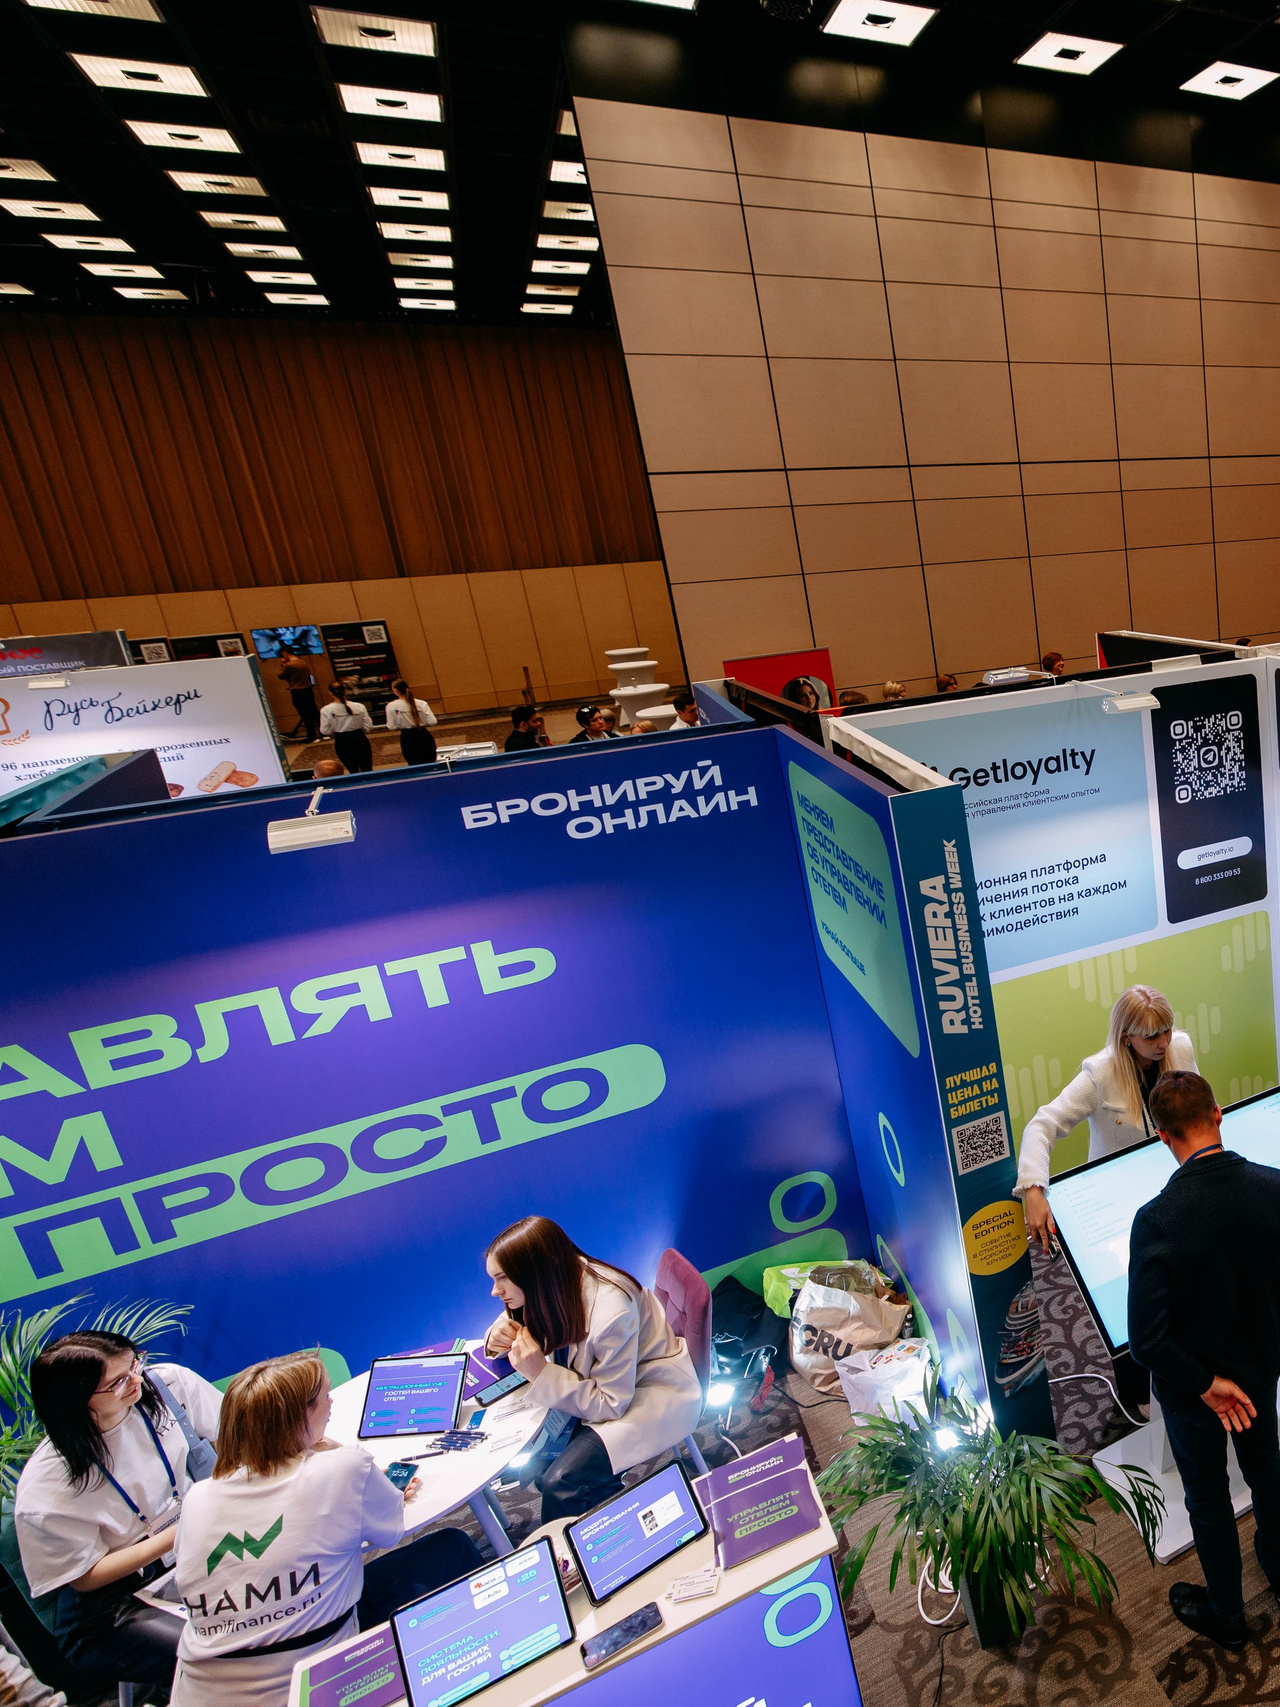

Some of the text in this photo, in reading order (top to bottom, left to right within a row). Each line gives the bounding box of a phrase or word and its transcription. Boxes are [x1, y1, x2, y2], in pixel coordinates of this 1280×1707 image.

[18, 660, 86, 673] ПОСТАВЩИК
[43, 688, 203, 731] Русь Бейкери
[1, 762, 18, 772] 96
[948, 748, 1097, 791] Getloyalty
[460, 759, 723, 830] БРОНИРУЙ
[971, 788, 1101, 819] управления клиентским опытом
[1004, 788, 1050, 803] платформа
[796, 790, 836, 834] МЕНЯЕМ
[801, 816, 886, 902] ПРЕДСТАВЛЕНИЕ
[1030, 853, 1107, 879] платформа
[1197, 846, 1234, 862] getloyalty.io
[806, 841, 888, 930] ОБ УПРАВЛЕНИИ
[811, 866, 848, 914] ОТЕЛЕМ
[1031, 875, 1079, 895] потока
[1200, 874, 1212, 884] 800
[1213, 872, 1224, 880] 333
[1224, 870, 1232, 878] 09
[1234, 868, 1241, 876] 53
[989, 897, 1056, 920] клиентов
[1058, 891, 1075, 904] на
[1077, 880, 1128, 900] каждом
[942, 838, 984, 1030] HOTEL BUSINESS WEEK
[919, 874, 969, 1034] RUVIERA
[945, 1062, 998, 1090] ЛУЧШАЯ
[947, 1077, 1000, 1105] ЦЕНА НА
[950, 1093, 999, 1119] БИЛЕТЫ
[14, 1067, 610, 1280] ПРОСТО
[971, 1209, 1016, 1232] SPECIAL
[974, 1218, 1016, 1240] EDITION
[978, 1235, 1022, 1257] СТИЛИСТИКЕ
[980, 1232, 1013, 1249] СОБЫТИЕ
[980, 1243, 1017, 1262] МОРСКОГО
[986, 1252, 1013, 1267] КРУИЗА
[728, 1456, 777, 1480] БРОНИРУЙ
[582, 1502, 640, 1540] БРОНИРОВАНИЯ
[726, 1490, 800, 1524] УПРАВЛЯТЬ
[739, 1500, 790, 1525] ОТЕЛЕМ
[580, 1516, 610, 1536] МОДУЛЬ
[739, 1508, 794, 1536] ПРОСТО
[183, 1562, 321, 1618] НАМИ
[194, 1592, 322, 1636] namifinance.ru
[418, 1634, 474, 1668] СИСТЕМА
[420, 1630, 498, 1676] ЛОЯЛЬНОСТИ
[422, 1644, 490, 1686] ДЛЯ ВАШИХ
[336, 1660, 398, 1695] УПРАВЛЯТЬ
[446, 1652, 492, 1681] ГОСТЕЙ
[344, 1676, 390, 1703] ПРОСТО
[345, 1669, 389, 1695] ОТЕЛЕМ
